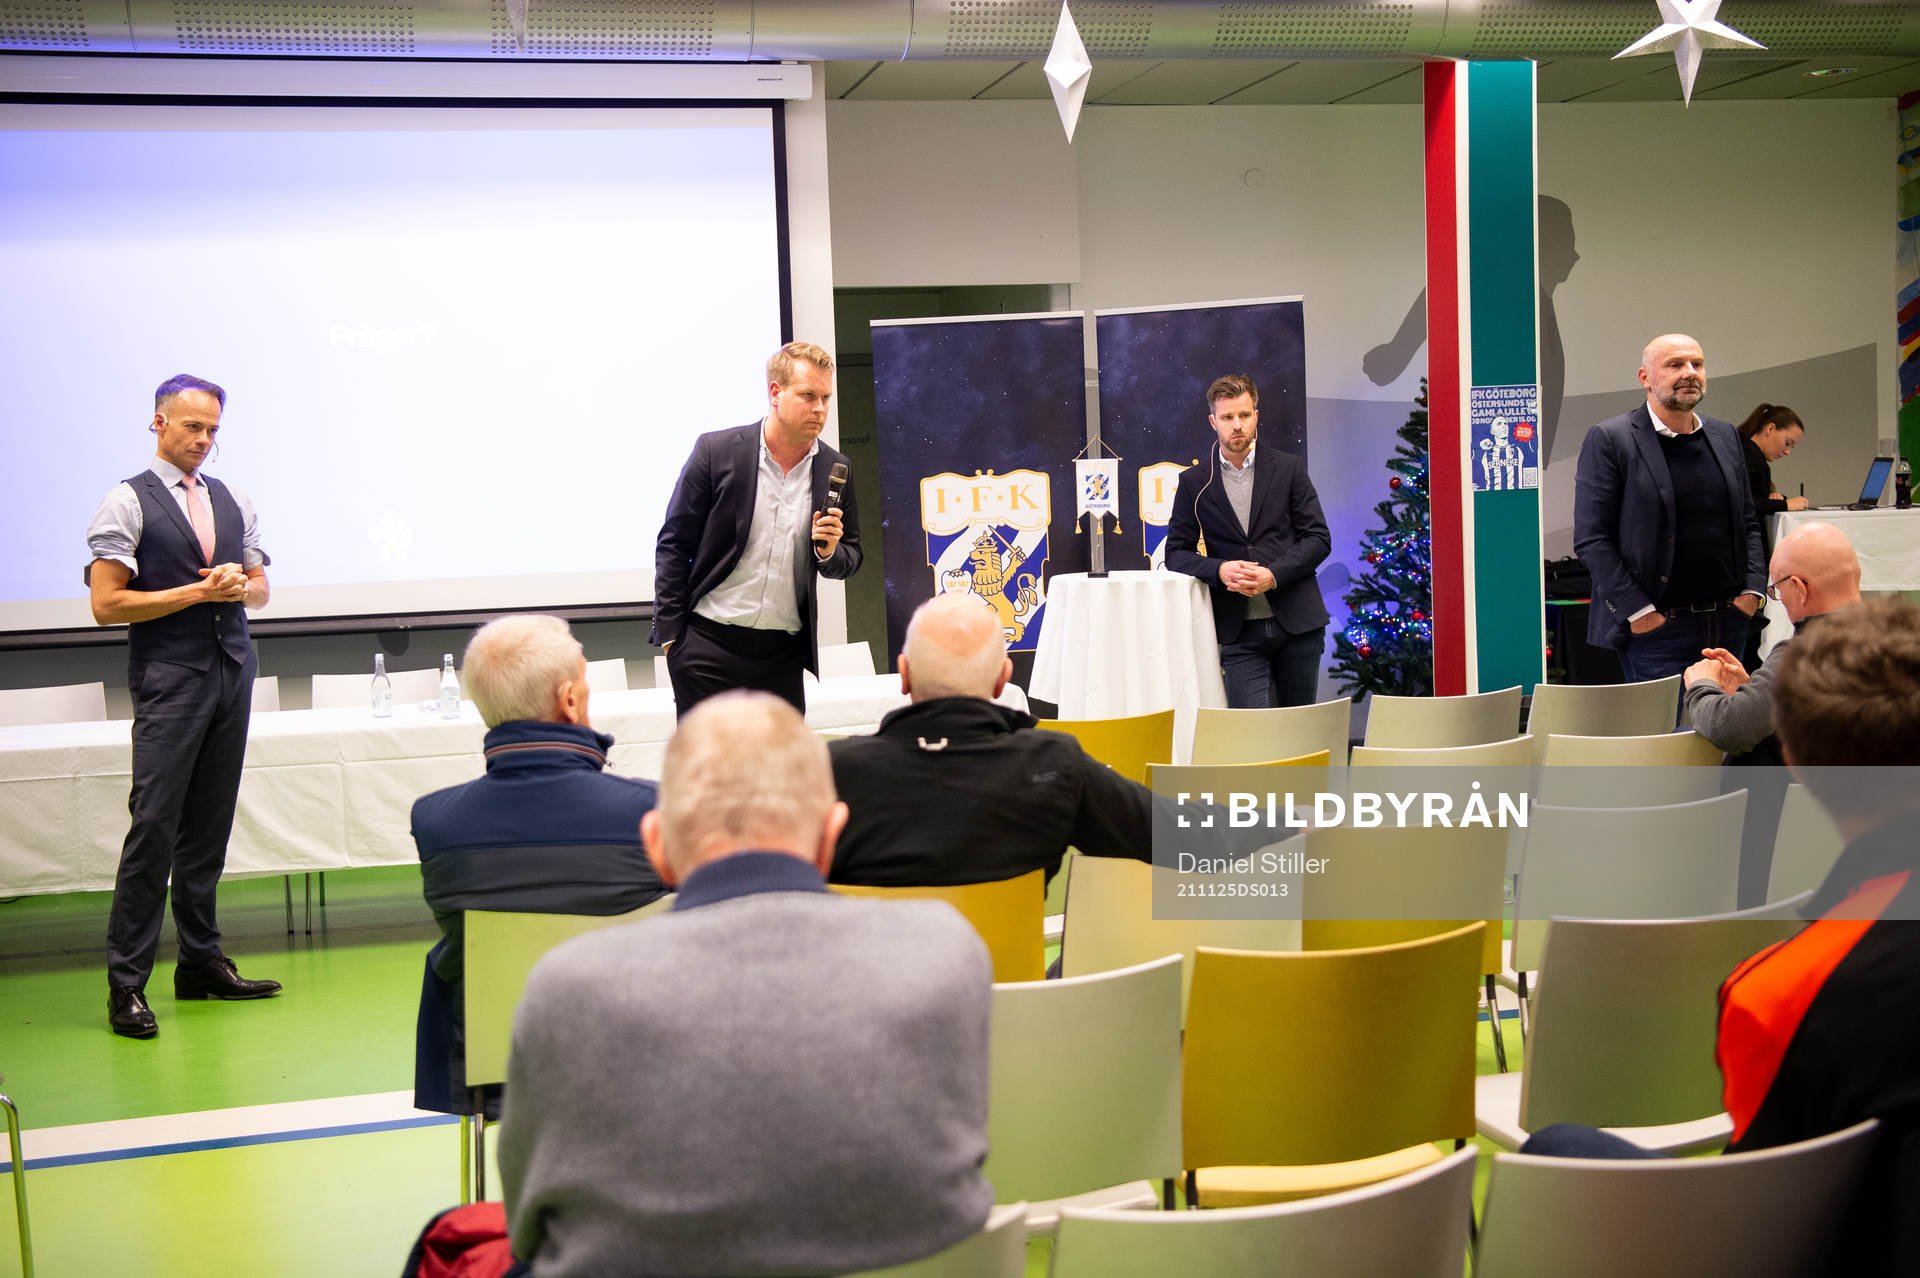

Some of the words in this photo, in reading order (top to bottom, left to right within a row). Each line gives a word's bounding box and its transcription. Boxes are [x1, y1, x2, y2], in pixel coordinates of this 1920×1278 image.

[1471, 389, 1485, 400] IFK
[1485, 388, 1536, 400] GÖTEBORG
[1471, 400, 1525, 409] ÖSTERSUNDS
[1488, 459, 1519, 469] SERNEKE
